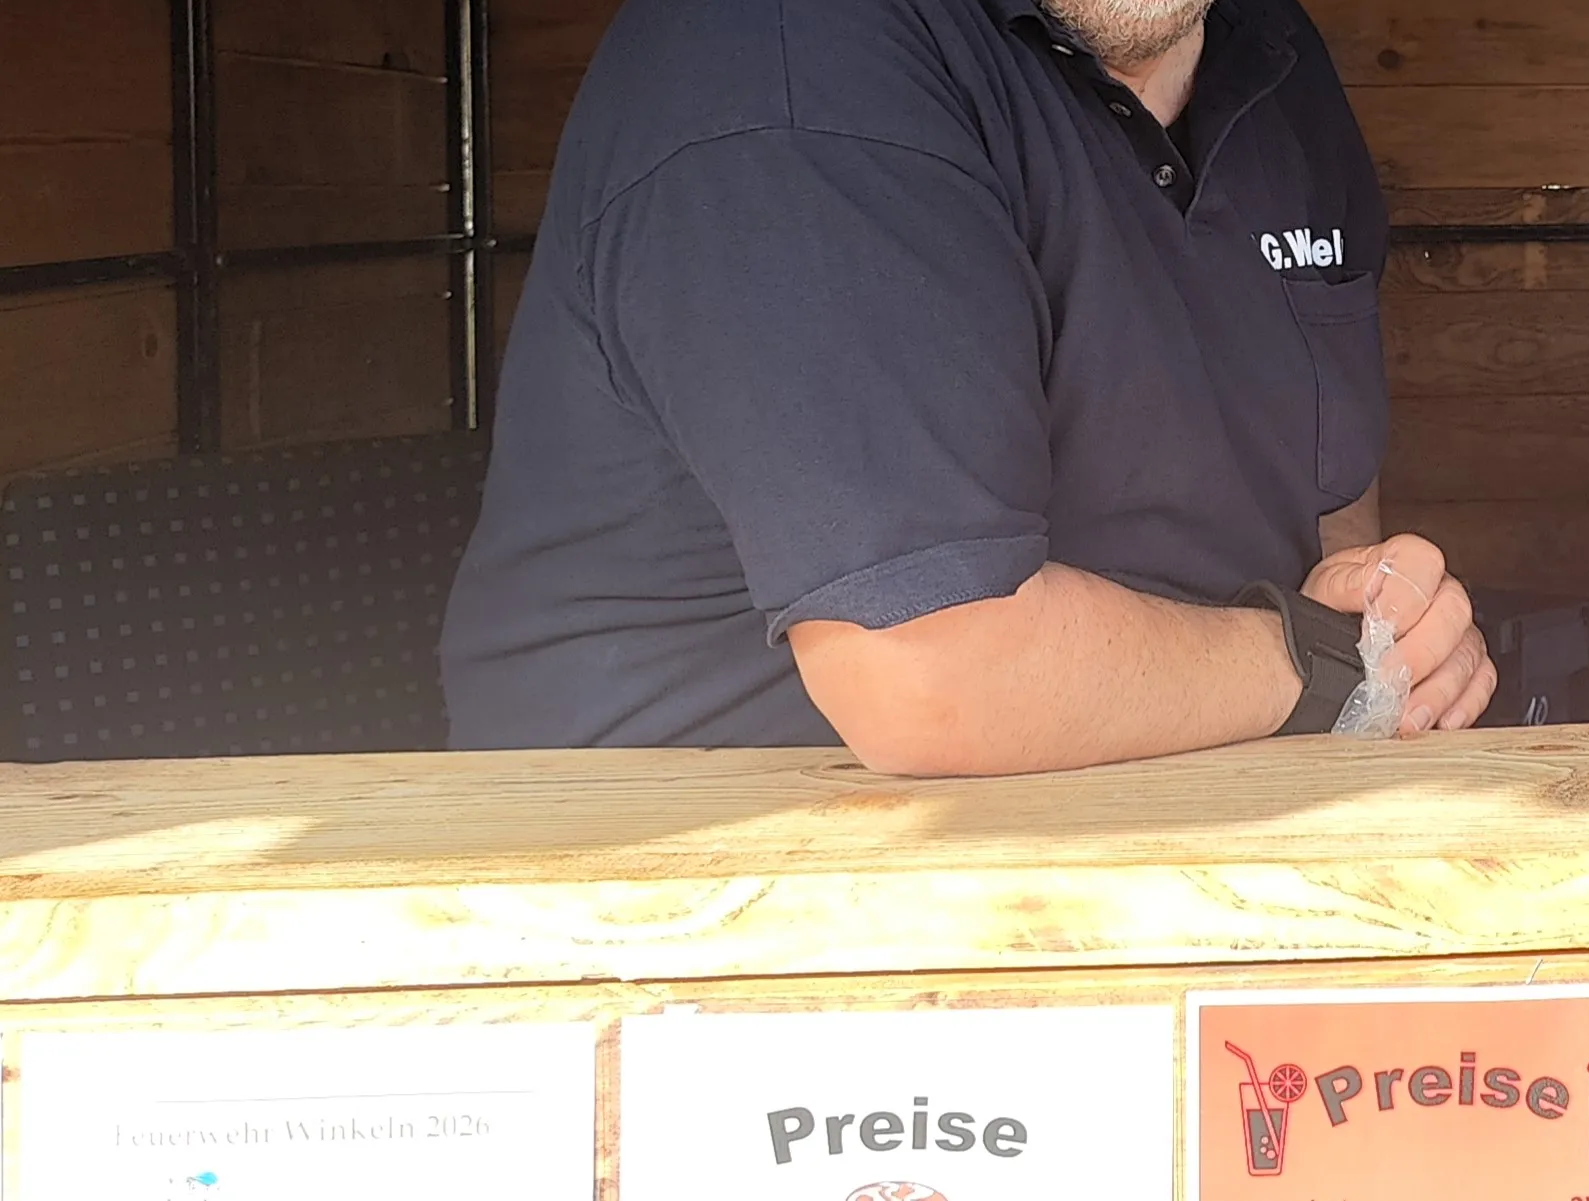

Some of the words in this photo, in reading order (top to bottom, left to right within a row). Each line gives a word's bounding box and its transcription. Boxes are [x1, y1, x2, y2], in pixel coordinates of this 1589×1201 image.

[1315, 1051, 1570, 1127] Preise
[427, 1115, 490, 1138] 2026
[767, 1097, 1029, 1165] Preise
